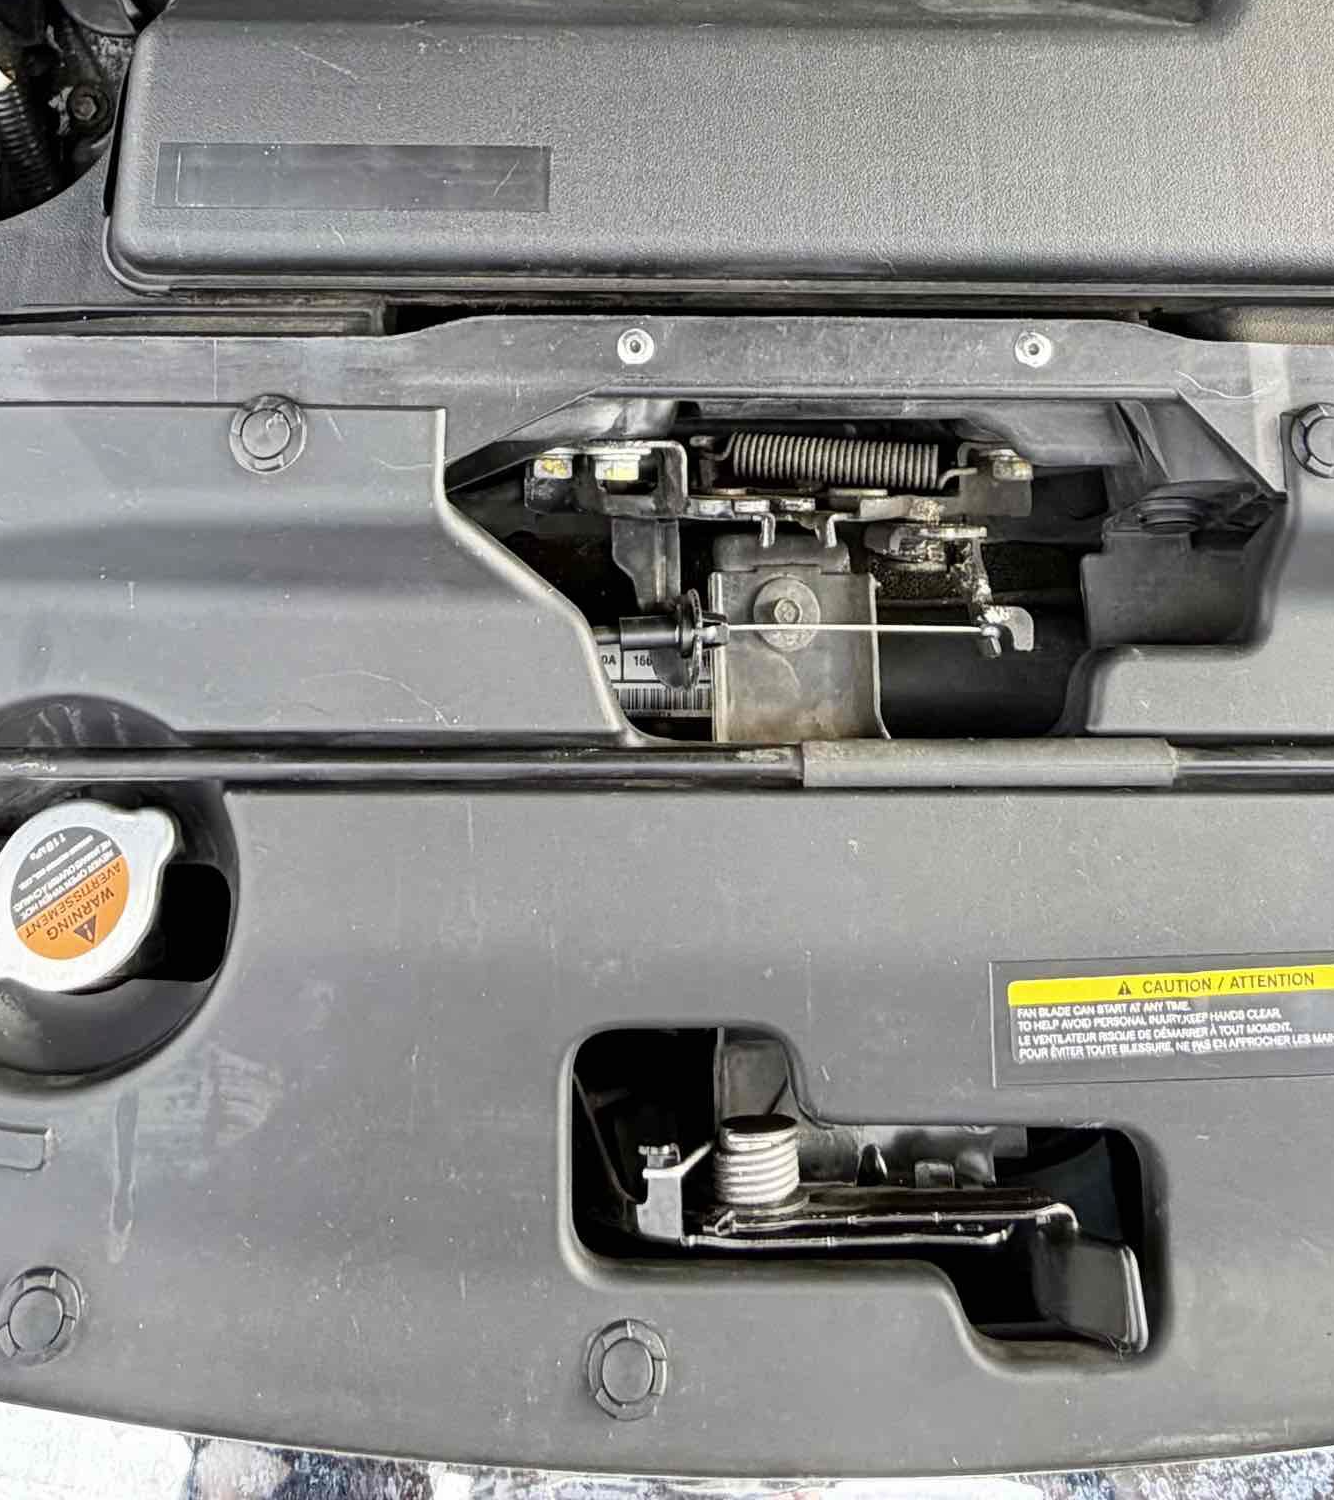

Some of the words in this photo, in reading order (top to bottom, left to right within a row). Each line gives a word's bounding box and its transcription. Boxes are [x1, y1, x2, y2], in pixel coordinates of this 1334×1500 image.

[26, 861, 121, 938] AVERTISSEMENT
[47, 888, 115, 940] WARNING
[1143, 978, 1211, 993] CAUTION
[1218, 977, 1224, 989] /
[1230, 972, 1314, 988] ATTENTION
[1018, 1008, 1037, 1018] FAN
[1039, 1006, 1071, 1017] BLADE
[1074, 1006, 1095, 1016] CAN
[1097, 1004, 1127, 1015] START
[1130, 1003, 1141, 1013] AT
[1144, 1002, 1164, 1012] ANY
[1018, 1021, 1032, 1032] TO
[1034, 1020, 1058, 1031] HELP
[1061, 1018, 1092, 1030] AVOID
[1094, 1016, 1146, 1028] PERSONAL
[1210, 1010, 1245, 1022] HANDS
[1018, 1035, 1031, 1047] LE
[1033, 1032, 1097, 1046] VENTILATEUR
[1099, 1031, 1136, 1043] RISQUE
[1138, 1030, 1152, 1040] DE
[1154, 1026, 1208, 1039] DÉMARRER
[1219, 1025, 1245, 1036] TOUT
[1020, 1047, 1048, 1059] POUR
[1051, 1045, 1084, 1058] ÉVITER
[1087, 1044, 1118, 1056] TOUTE
[1176, 1041, 1191, 1052] NE
[1192, 1040, 1212, 1053] PAS
[1213, 1038, 1228, 1050] EN
[1228, 1035, 1291, 1049] APPROCHER
[1292, 1034, 1311, 1045] LES
